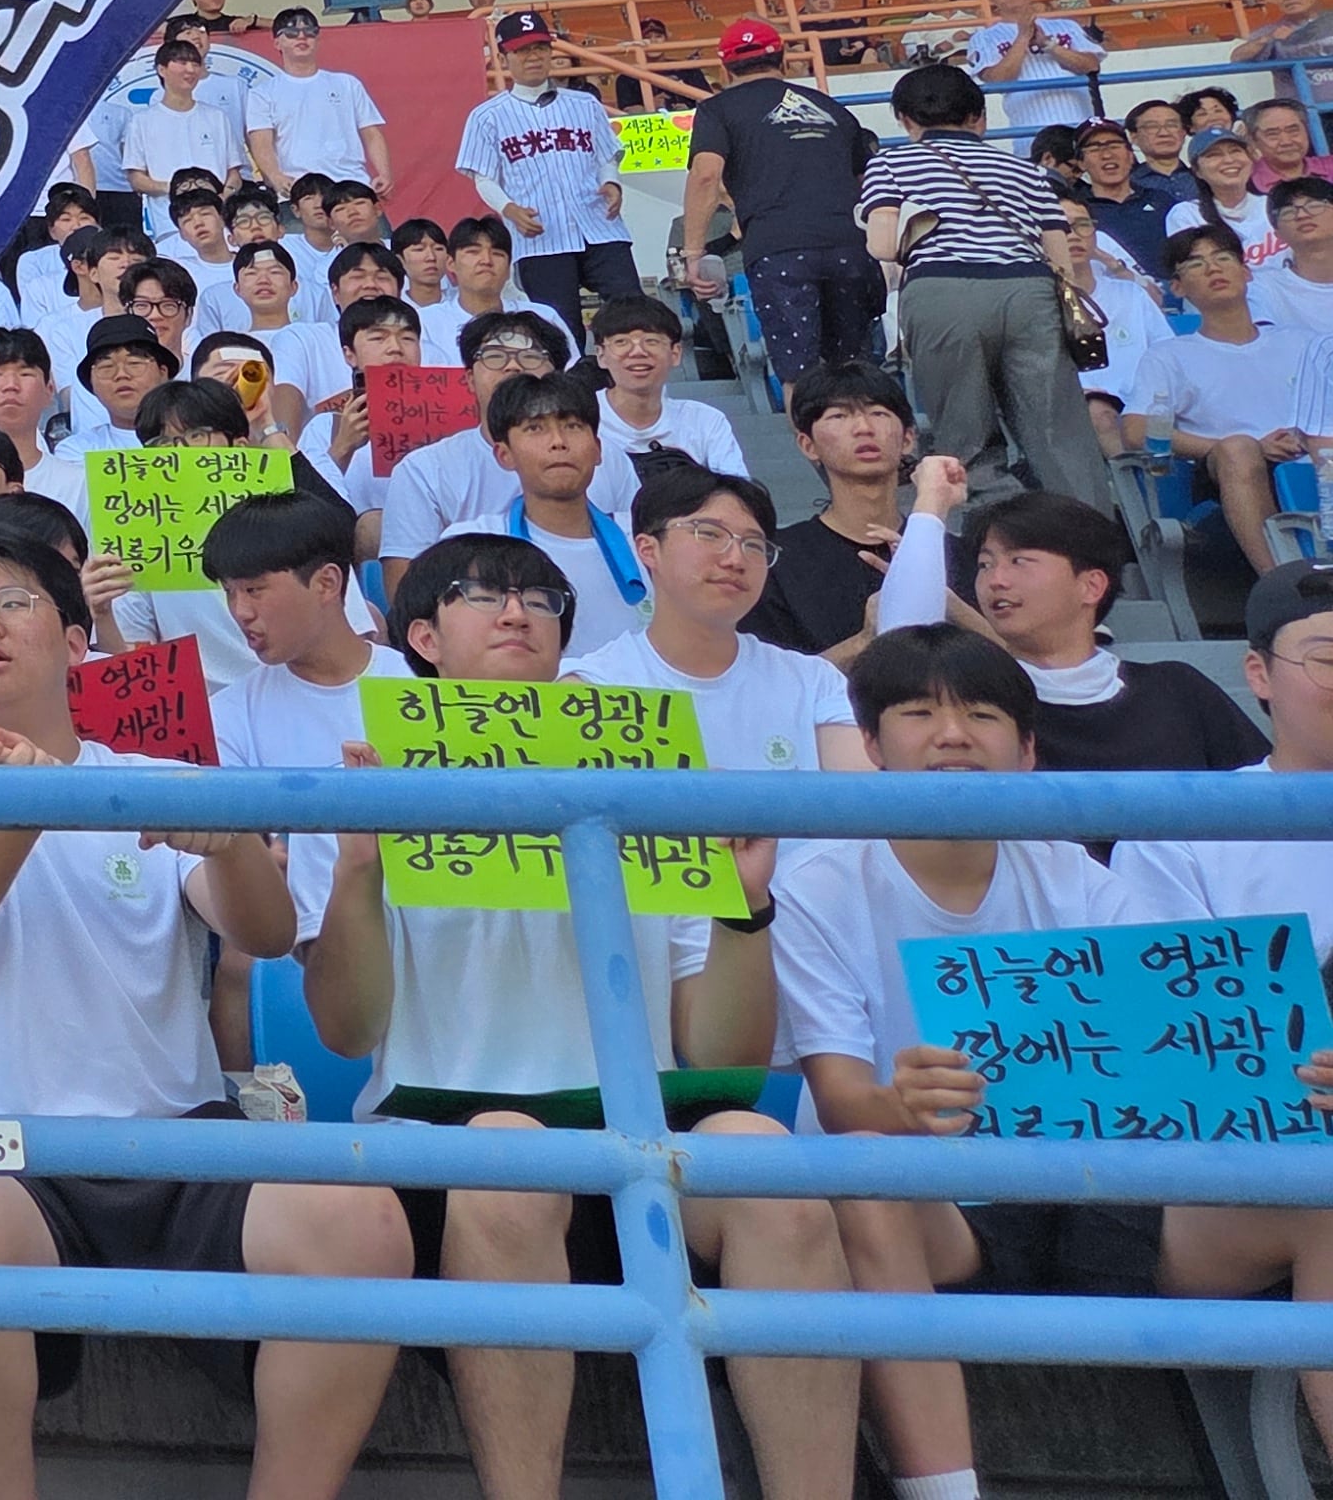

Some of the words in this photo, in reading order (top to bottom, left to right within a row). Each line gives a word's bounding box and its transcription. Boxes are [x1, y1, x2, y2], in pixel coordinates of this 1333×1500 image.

[520, 15, 535, 31] S
[384, 371, 449, 396] 하늘엔
[102, 451, 181, 484] 하늘엔
[195, 451, 270, 484] 영광!
[103, 489, 186, 527] 땅에는
[100, 643, 179, 700] 영광!
[109, 691, 186, 749] 세광!
[396, 682, 541, 740] 하늘엔
[559, 687, 672, 746] 영광!
[934, 935, 1104, 1010] 하늘엔
[1139, 923, 1292, 999] 영광!
[951, 1018, 1122, 1084] 땅에는
[1142, 1002, 1306, 1078] 세광!
